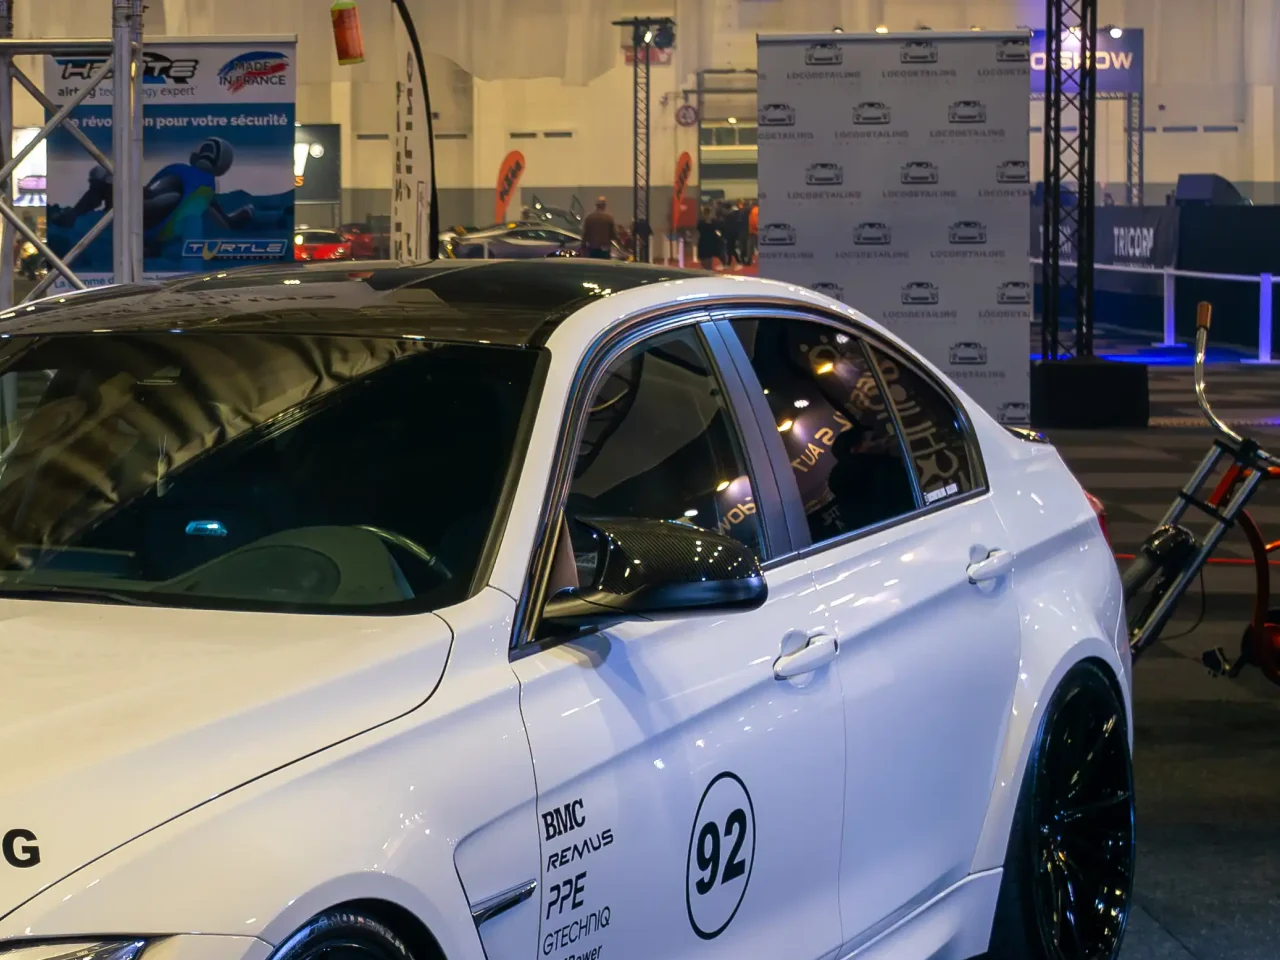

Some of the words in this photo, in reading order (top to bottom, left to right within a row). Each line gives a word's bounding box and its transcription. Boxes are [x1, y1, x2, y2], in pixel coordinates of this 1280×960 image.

[234, 61, 269, 71] MADE
[786, 71, 861, 80] LOCODETAILING
[881, 69, 957, 78] LOCODETAILING
[219, 76, 233, 86] IN
[236, 75, 287, 86] FRANCE
[160, 86, 195, 98] expert
[156, 116, 189, 132] pour
[191, 115, 227, 126] votre
[230, 113, 288, 126] sécurité
[834, 130, 909, 139] LOCODETAILING
[929, 129, 1006, 138] LOCODETAILING
[787, 191, 862, 200] LOCODETAILING
[882, 190, 957, 199] LOCODETAILING
[188, 241, 283, 260] TURTLE
[835, 250, 909, 259] LOCODETAILING
[930, 250, 1006, 259] LOCODETAILING
[882, 310, 957, 319] LOCODETAILING
[541, 798, 586, 842] BMC
[546, 828, 614, 872] REMUS
[695, 808, 747, 895] 92
[546, 871, 587, 920] PPE
[542, 906, 611, 956] GTECHNIQ
